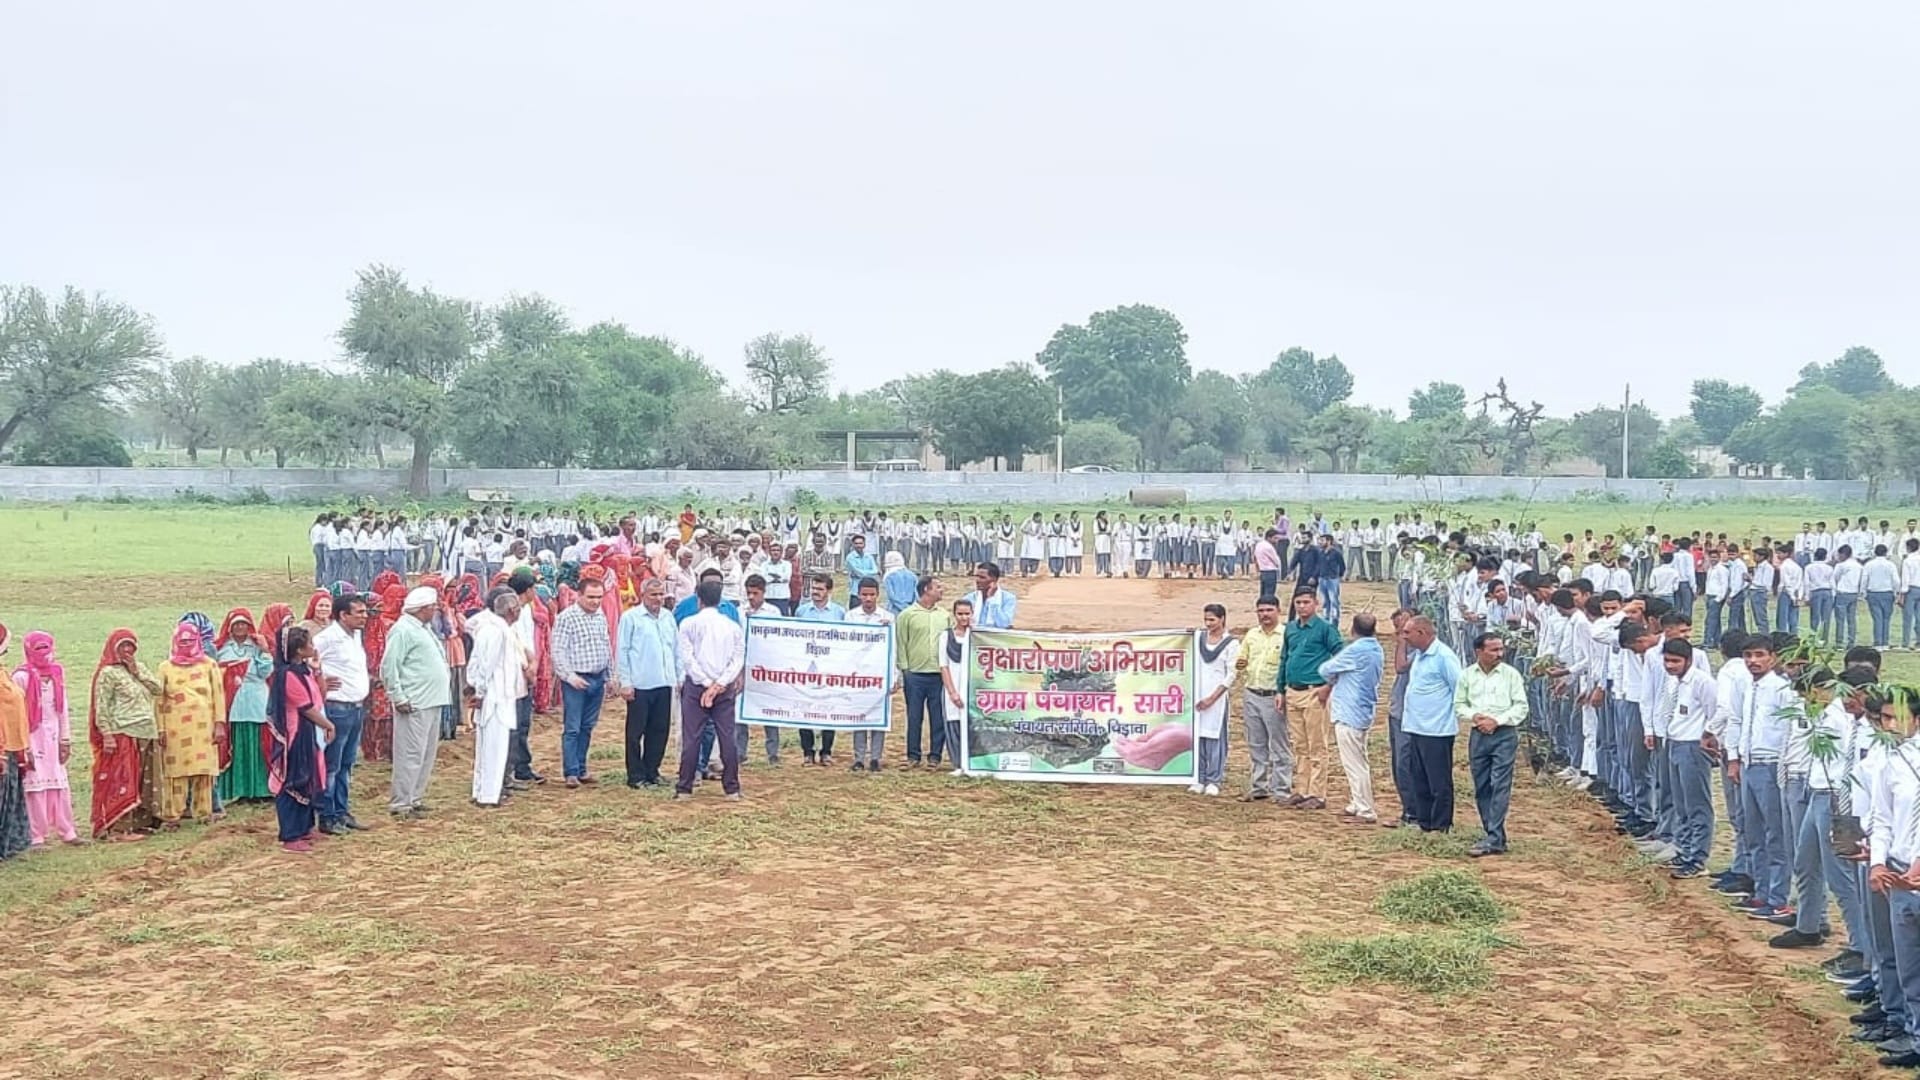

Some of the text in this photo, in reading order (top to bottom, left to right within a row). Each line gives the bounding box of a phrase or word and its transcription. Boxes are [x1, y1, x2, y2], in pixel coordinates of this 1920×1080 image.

[977, 641, 1186, 679] वृक्षारोपण अभियान
[976, 683, 1184, 715] ग्राम पंचायत, सारी
